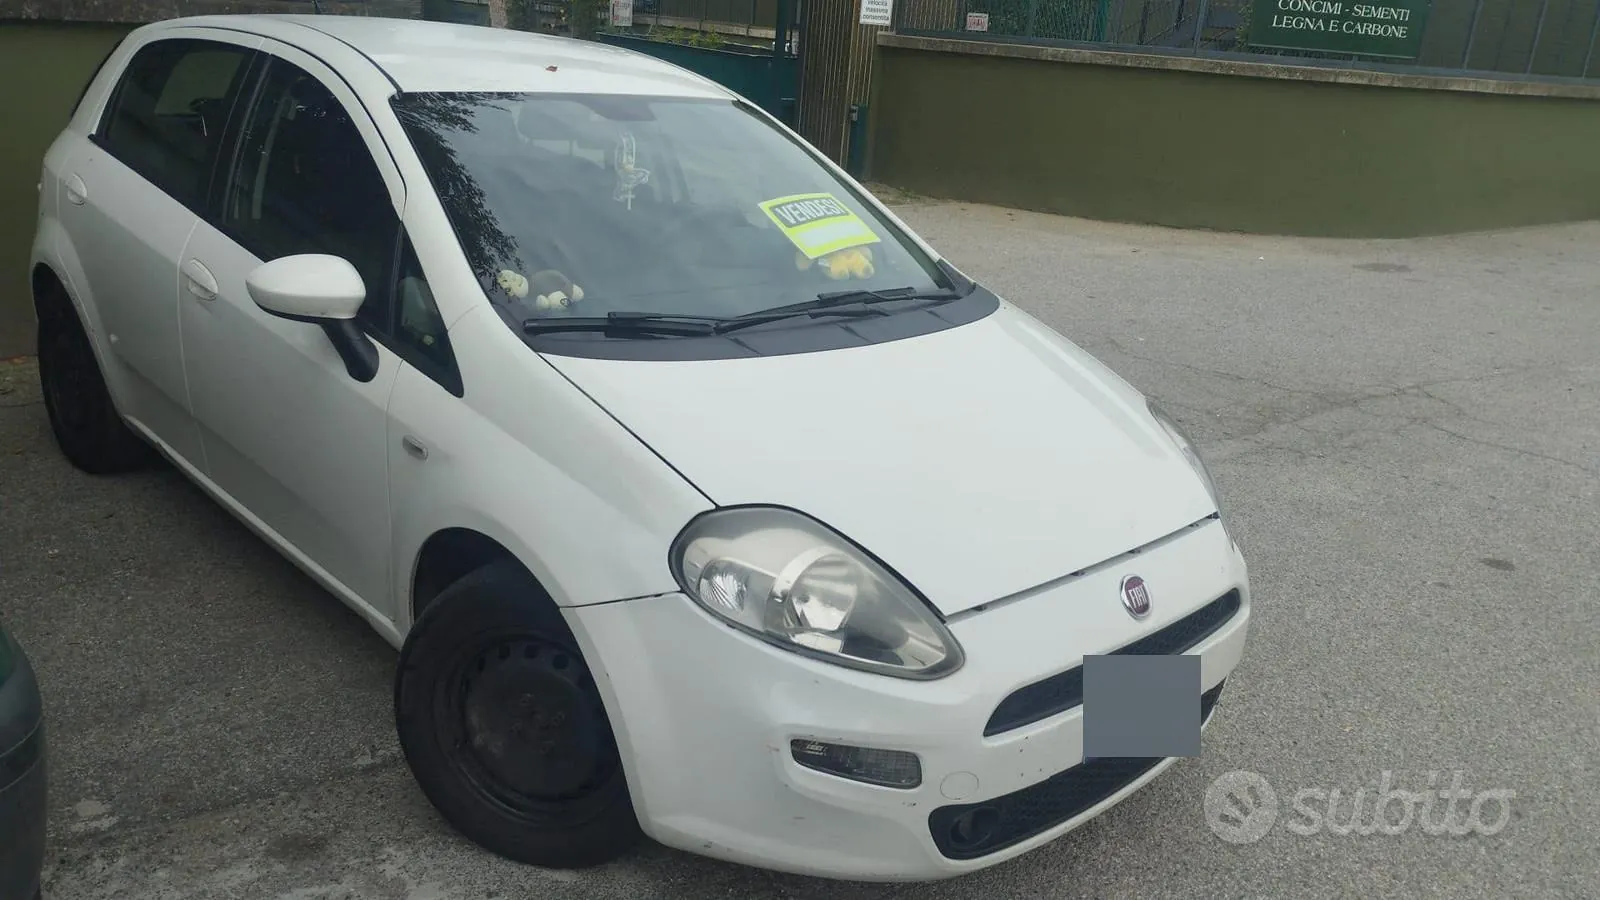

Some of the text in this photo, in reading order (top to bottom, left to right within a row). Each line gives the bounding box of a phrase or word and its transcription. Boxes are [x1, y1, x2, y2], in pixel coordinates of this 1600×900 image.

[1278, 0, 1342, 15] CONCIMI
[1352, 4, 1410, 21] SEMENTI
[1272, 15, 1408, 38] LEGNA E CARBONE
[774, 198, 846, 224] VENDESI
[1127, 584, 1148, 609] FIAT
